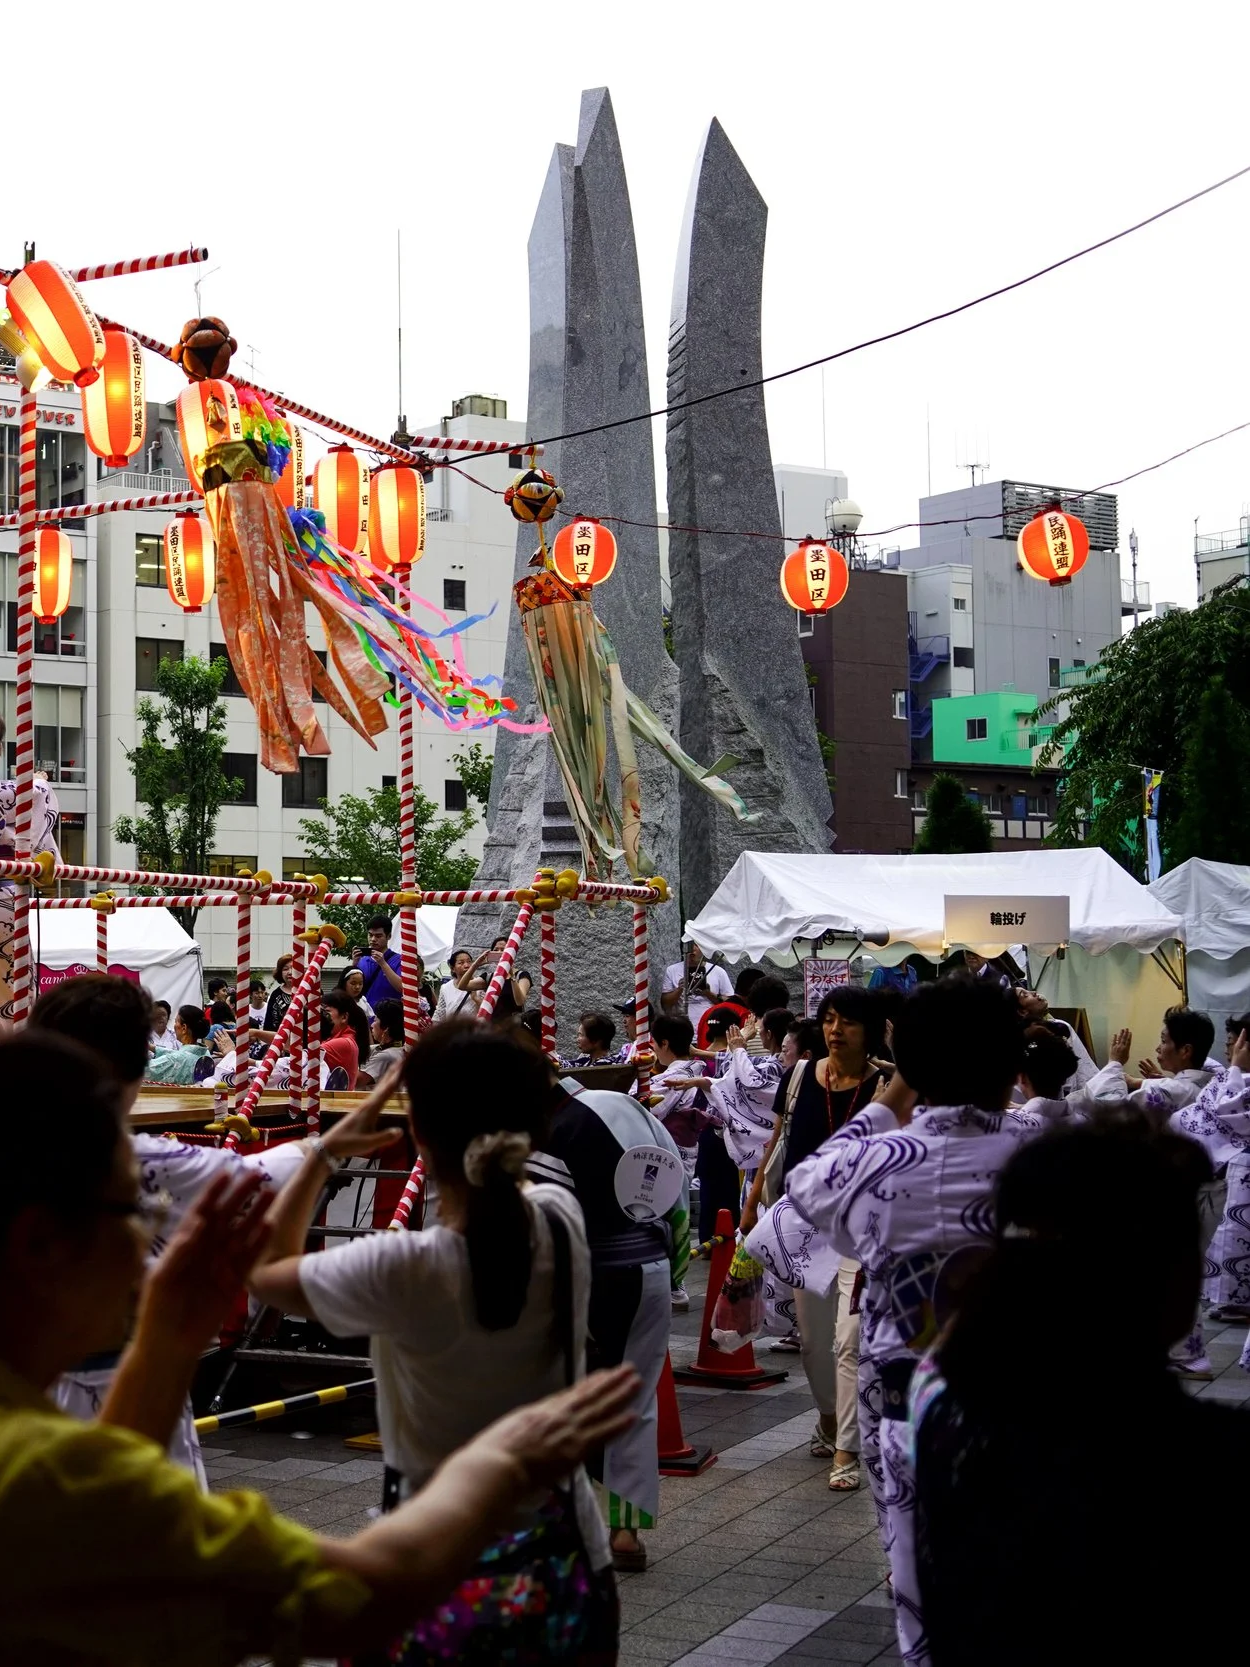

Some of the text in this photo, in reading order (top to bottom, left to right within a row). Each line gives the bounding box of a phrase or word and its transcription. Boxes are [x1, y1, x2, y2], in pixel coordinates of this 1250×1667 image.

[575, 526, 592, 575] 墨田区
[810, 549, 826, 601] 墨田区
[990, 911, 1027, 926] 輪投げ
[40, 971, 71, 985] cand
[810, 973, 847, 984] わなげ
